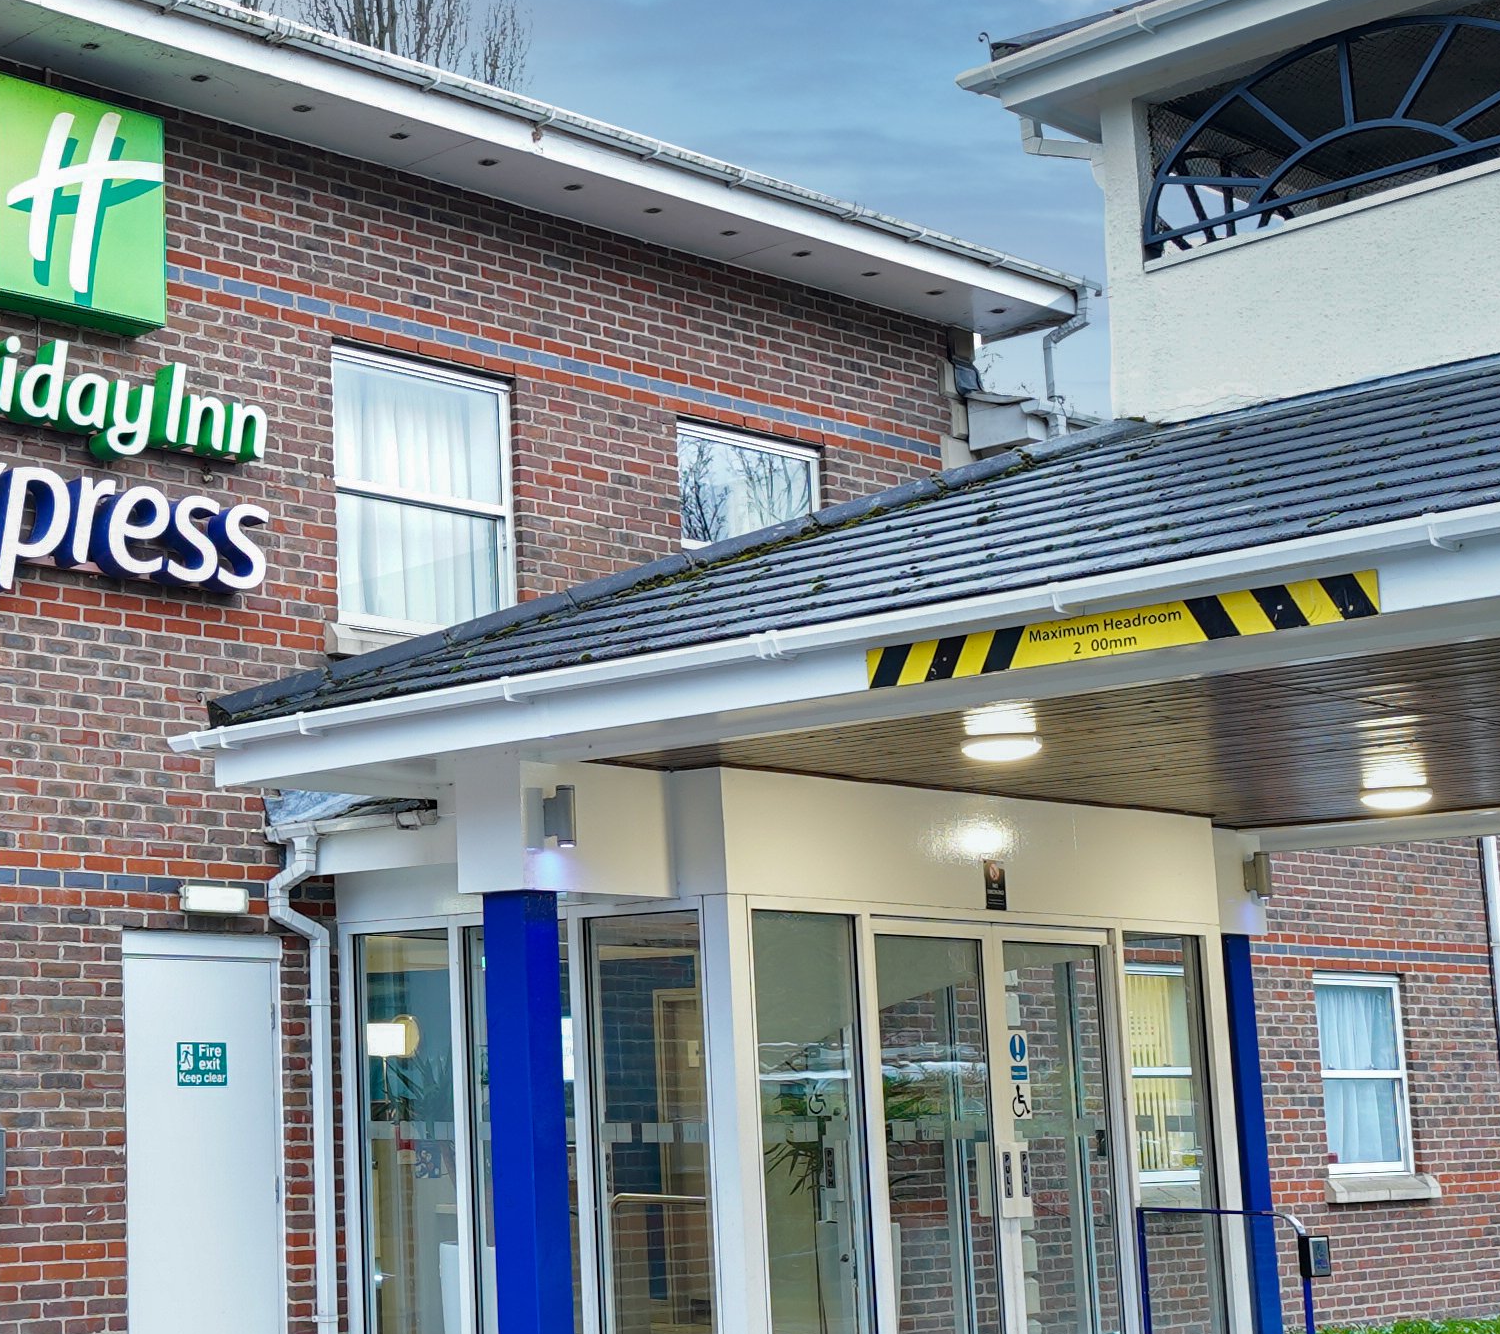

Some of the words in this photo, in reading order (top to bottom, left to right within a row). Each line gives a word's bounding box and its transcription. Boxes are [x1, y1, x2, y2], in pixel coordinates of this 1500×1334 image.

[162, 362, 269, 460] Inn
[1028, 622, 1100, 643] Maximum
[1103, 609, 1183, 632] Headroom
[198, 1044, 222, 1057] Fire
[198, 1058, 221, 1070] exit
[179, 1072, 202, 1085] Keep
[203, 1072, 226, 1083] clear
[826, 1149, 834, 1187] PUSH
[1004, 1154, 1012, 1196] PULL
